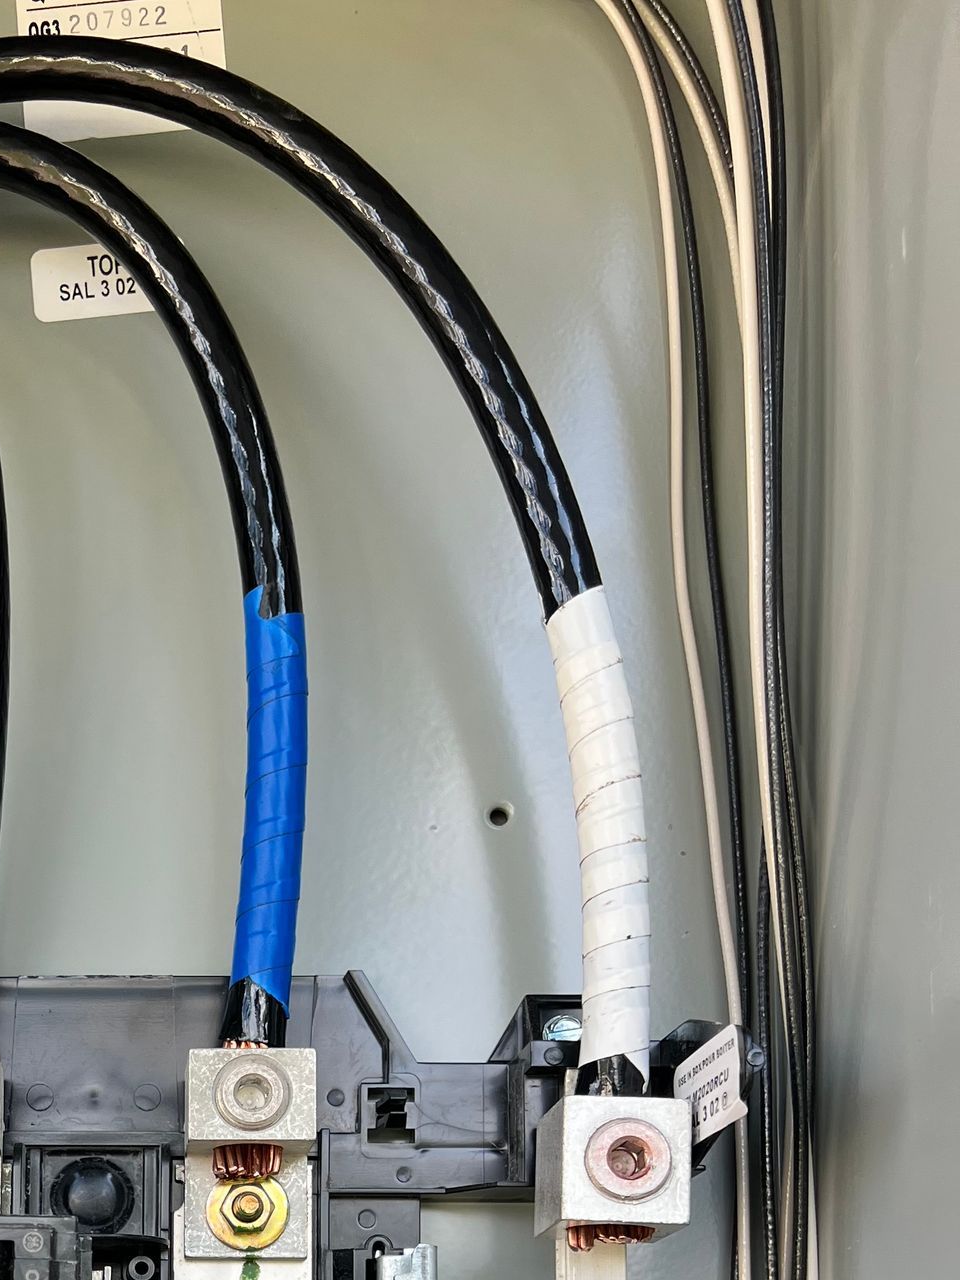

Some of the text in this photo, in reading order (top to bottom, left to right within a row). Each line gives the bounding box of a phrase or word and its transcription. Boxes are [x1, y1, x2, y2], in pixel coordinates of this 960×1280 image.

[69, 5, 167, 34] 207922
[59, 277, 136, 301] SAL 3 02
[703, 1105, 708, 1122] 3
[709, 1097, 720, 1118] 02
